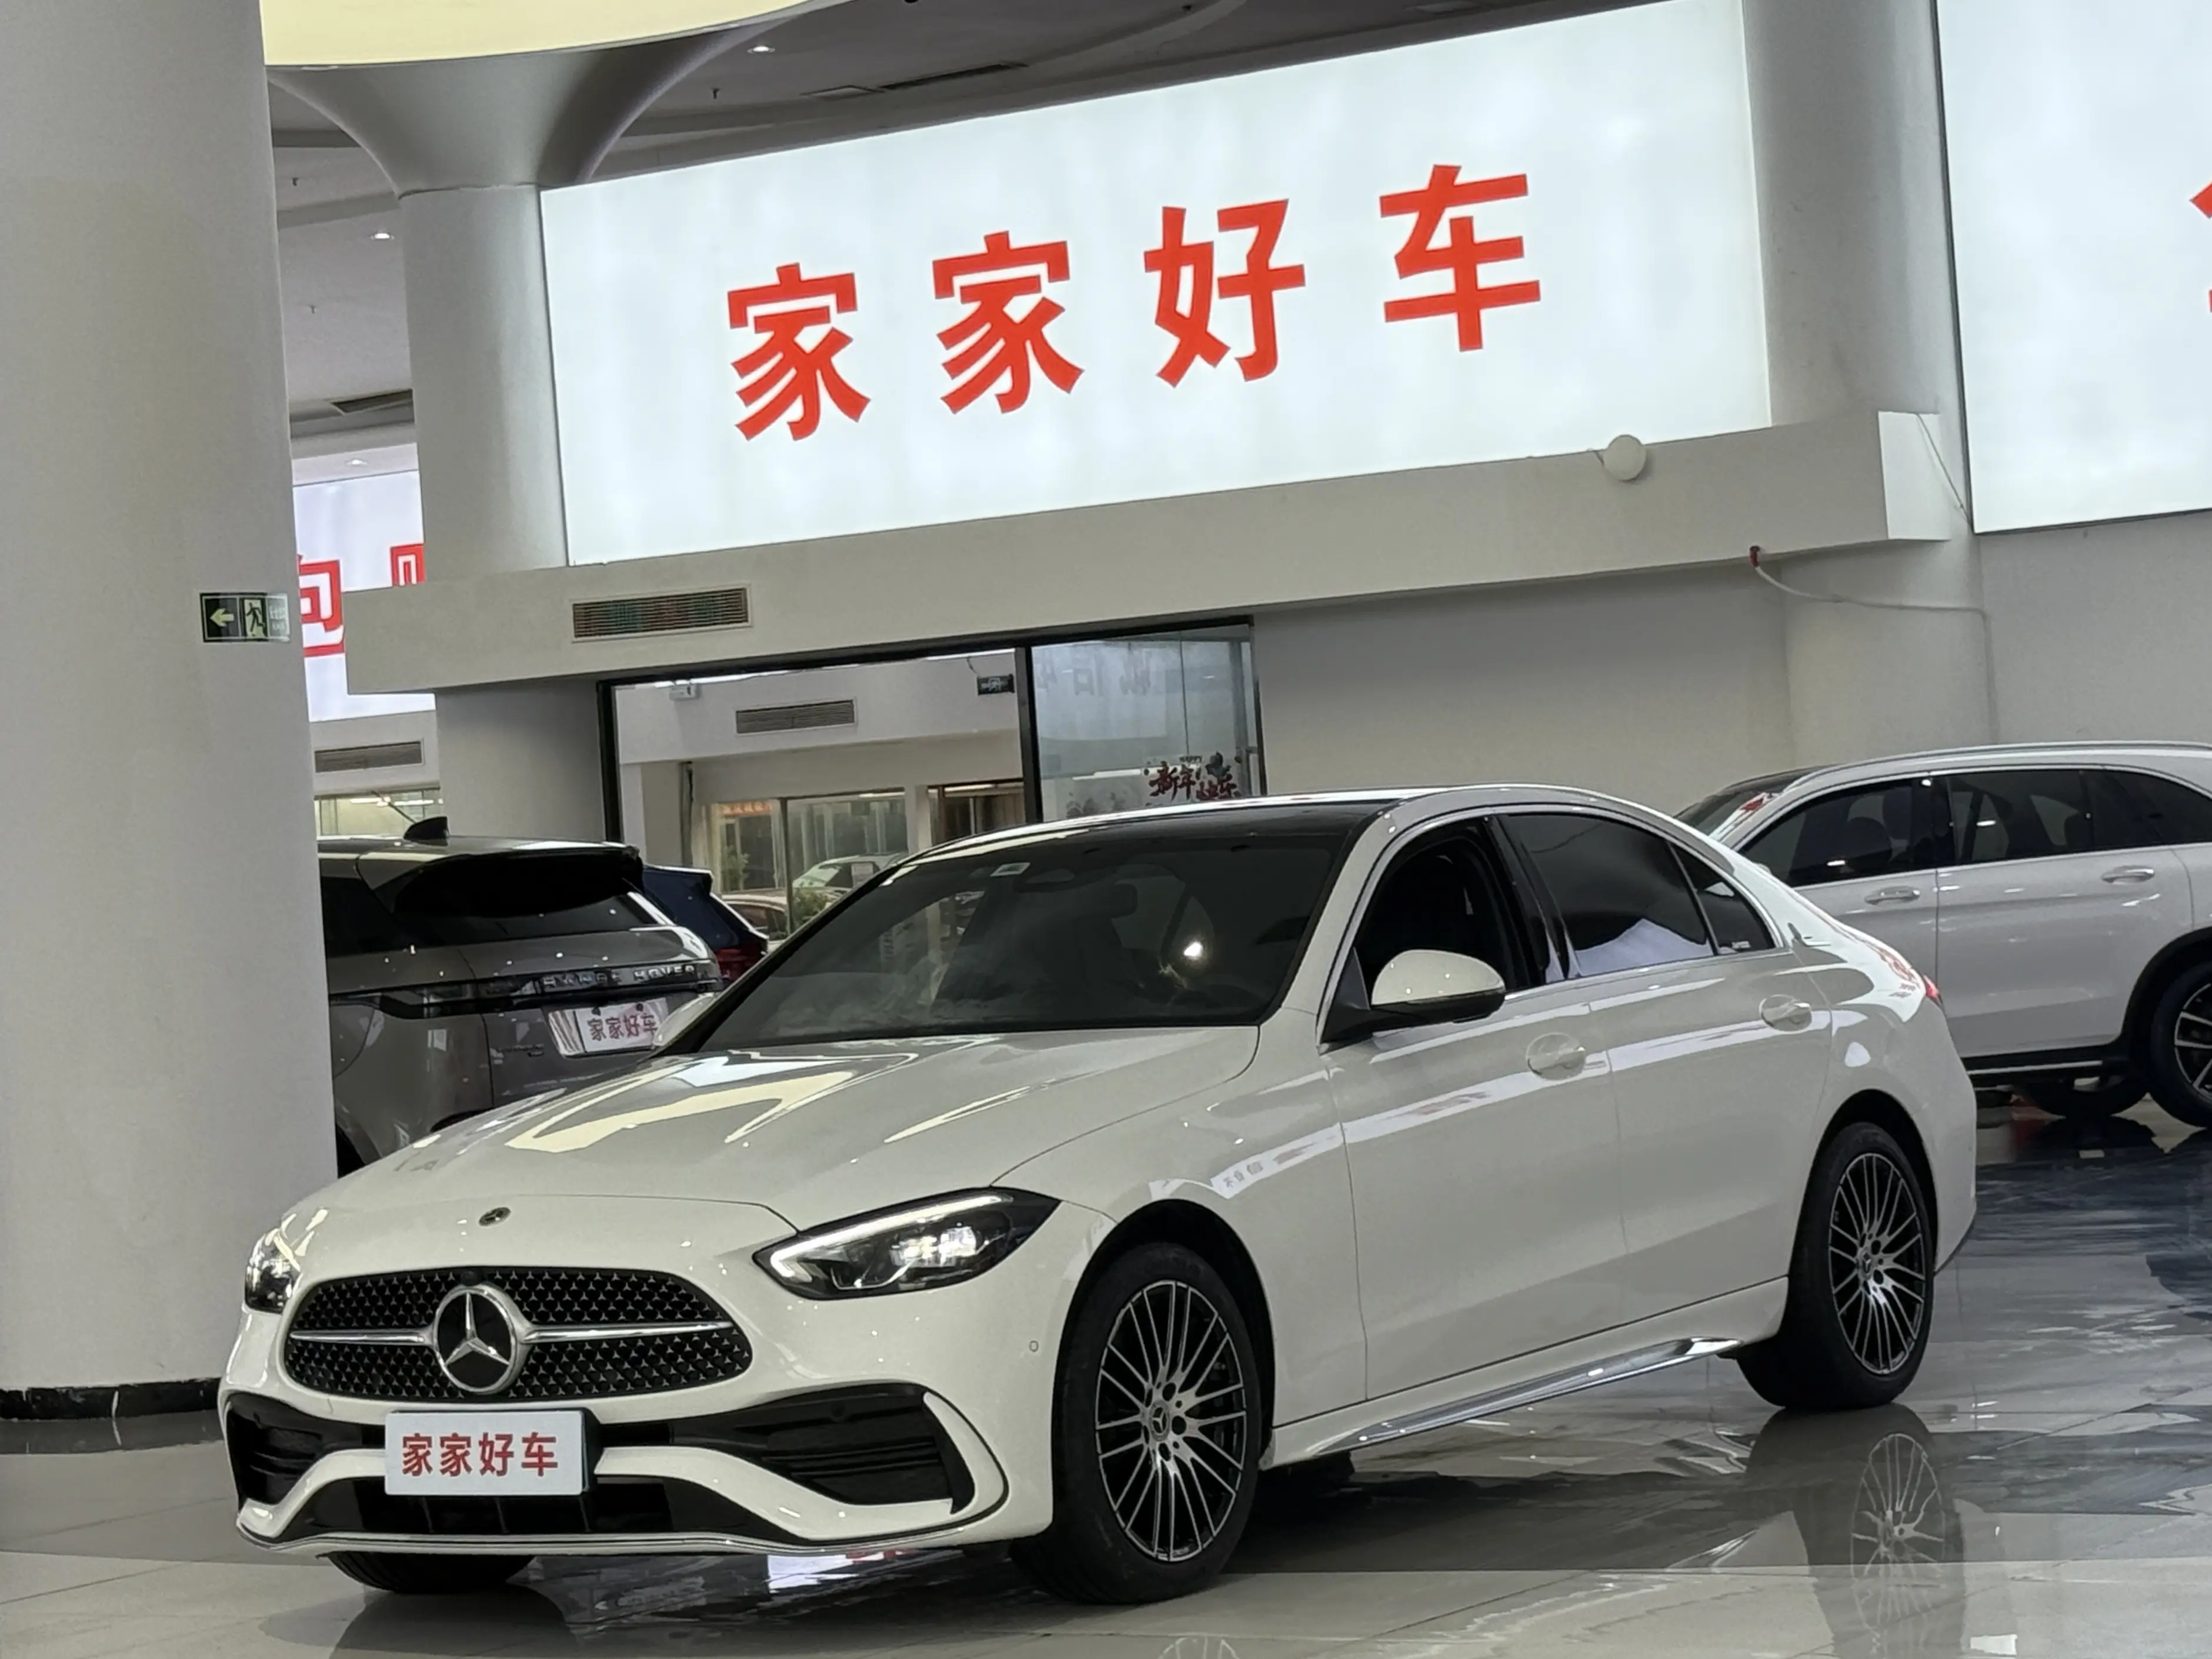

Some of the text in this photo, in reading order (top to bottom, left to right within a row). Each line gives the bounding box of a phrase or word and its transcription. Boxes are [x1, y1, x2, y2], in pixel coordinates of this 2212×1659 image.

[727, 164, 1542, 442] 家家好车
[587, 1013, 659, 1042] 家家好车
[402, 1431, 559, 1477] 家家好车
